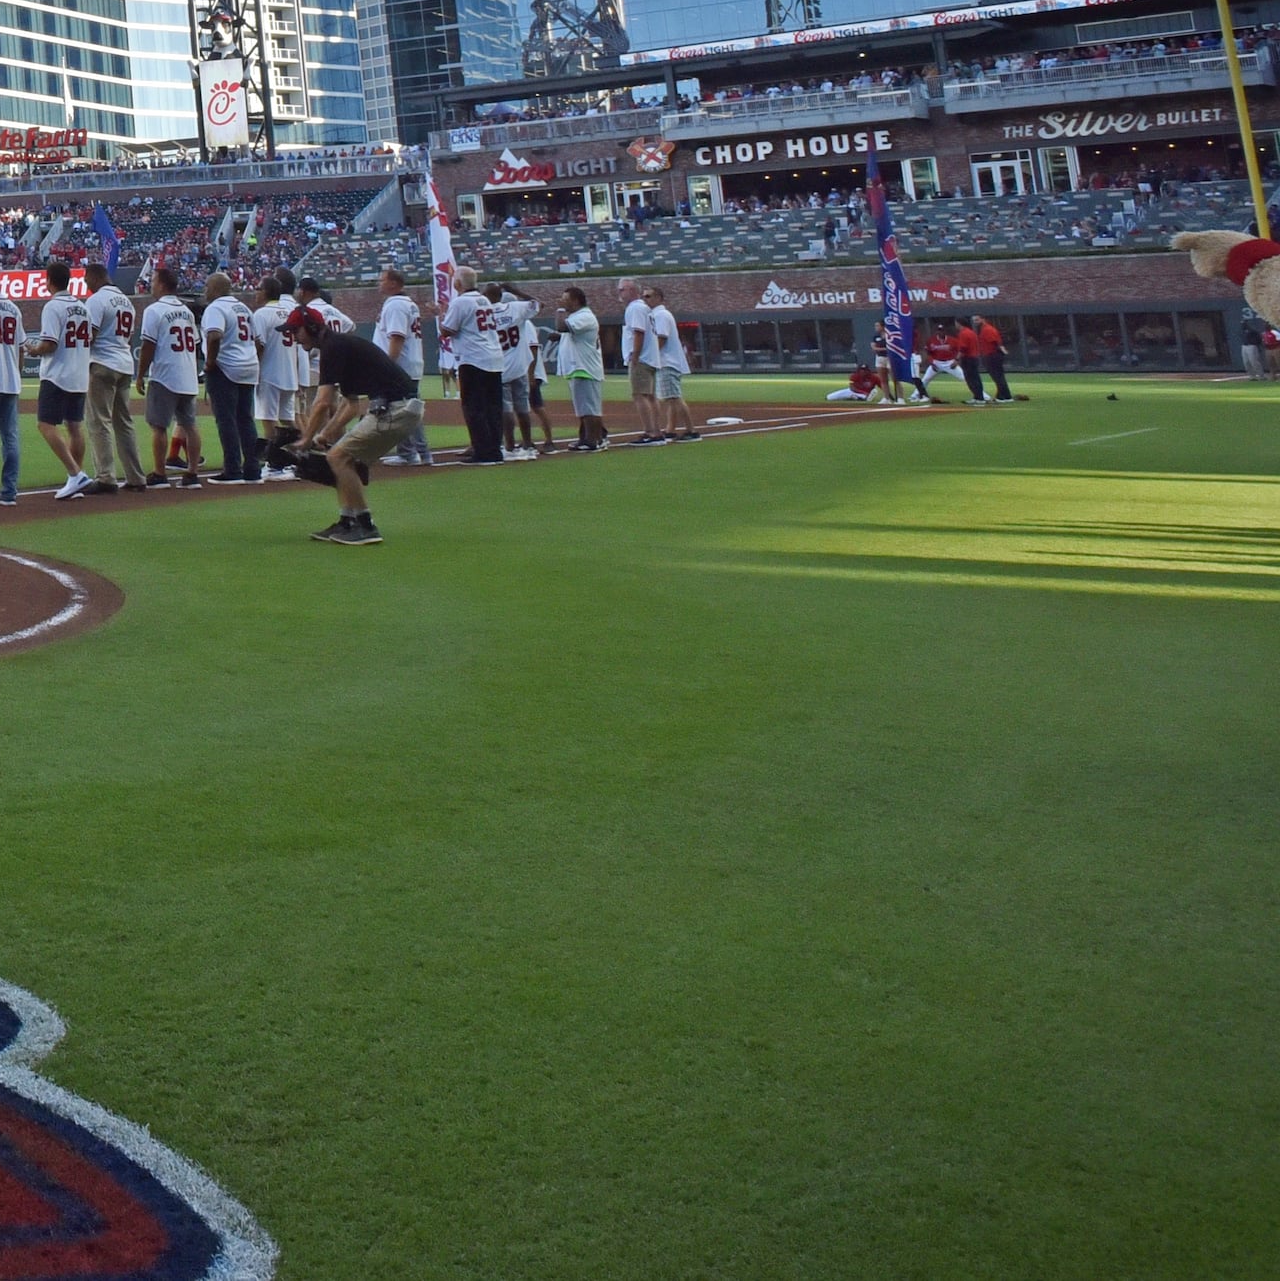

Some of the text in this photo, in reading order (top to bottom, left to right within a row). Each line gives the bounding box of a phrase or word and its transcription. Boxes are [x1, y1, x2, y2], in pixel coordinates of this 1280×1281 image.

[933, 6, 1016, 26] Coors LIGHT
[794, 26, 869, 44] Coors LIGHT
[669, 44, 735, 61] Coors LIGHT
[1003, 107, 1223, 140] THE Silver BULLET
[25, 126, 87, 149] Farm
[695, 142, 774, 167] CHOP
[787, 130, 893, 159] HOUSE
[489, 159, 556, 185] Coors
[556, 157, 616, 178] LIGHT
[761, 287, 809, 305] Coors
[811, 291, 856, 304] LIGHT
[950, 285, 999, 300] CHOP
[65, 321, 89, 348] 24
[115, 309, 133, 338] 19
[170, 326, 195, 352] 36
